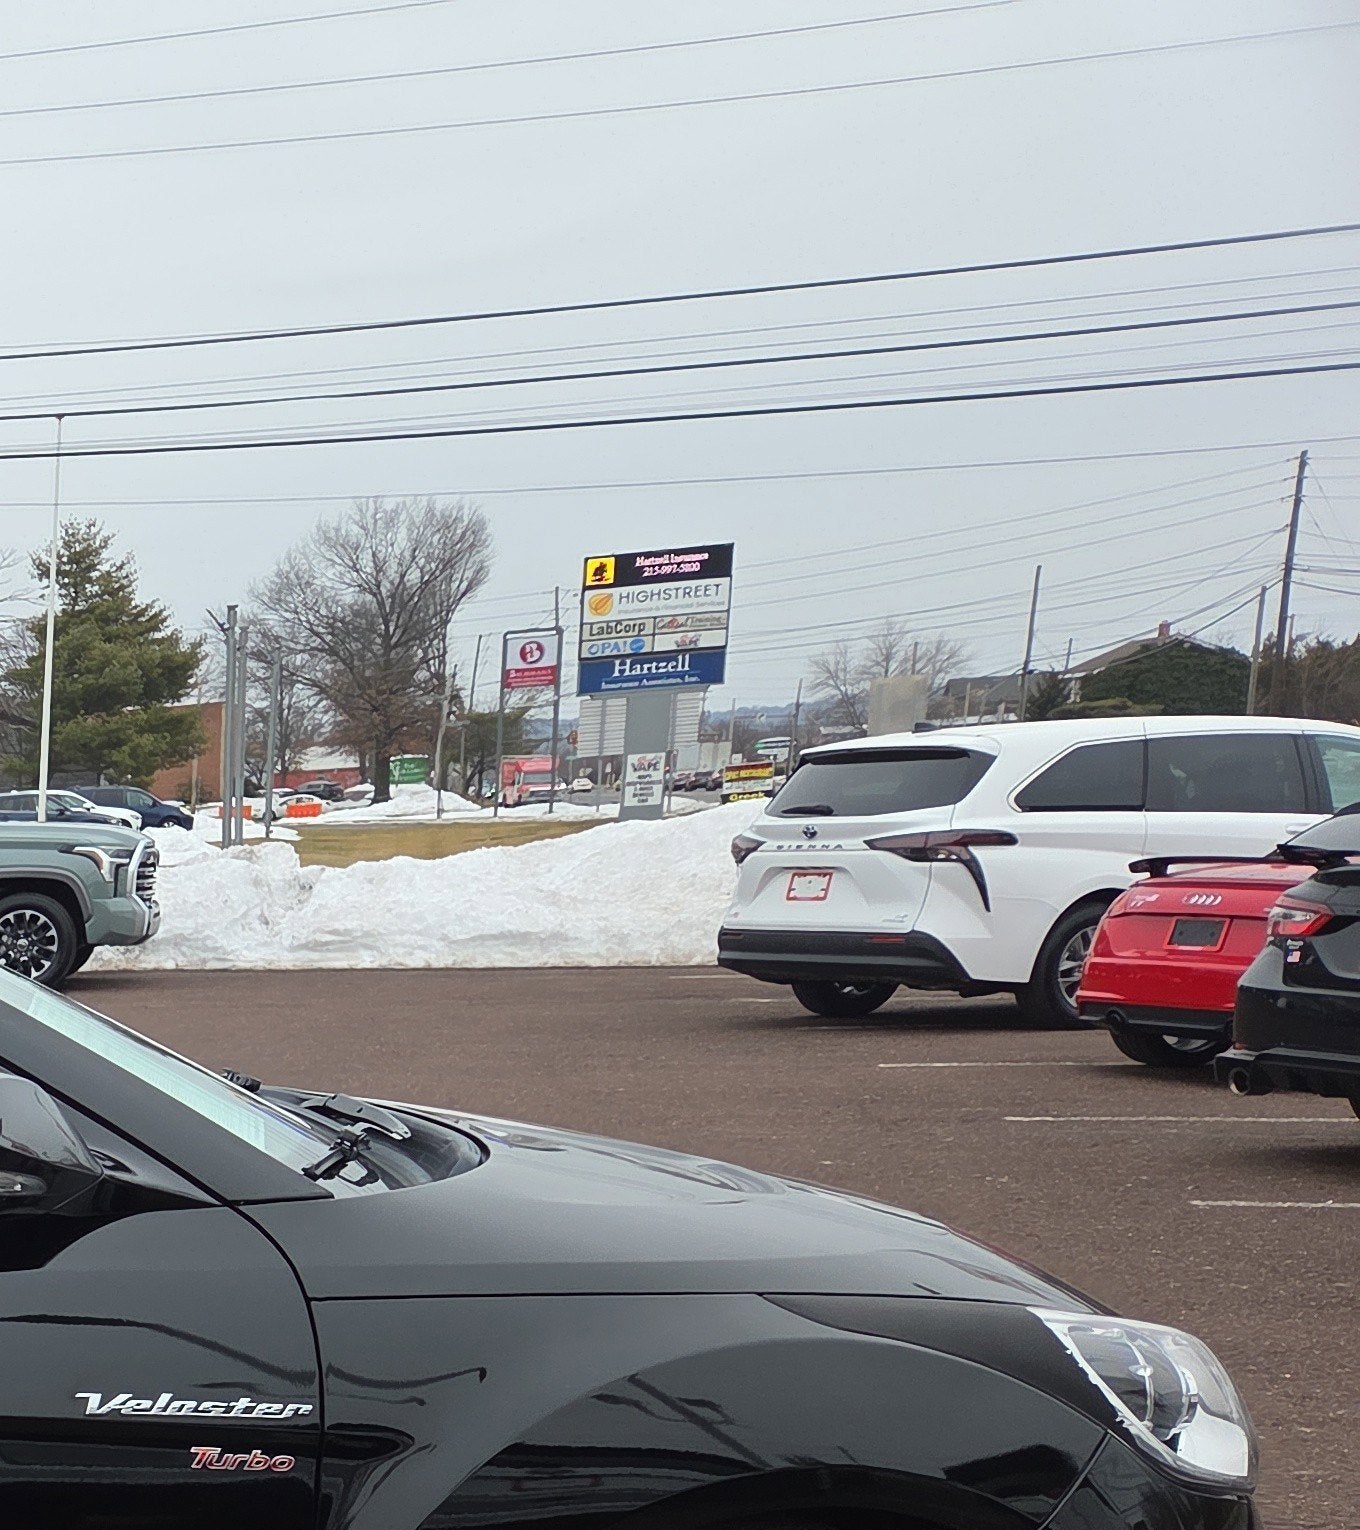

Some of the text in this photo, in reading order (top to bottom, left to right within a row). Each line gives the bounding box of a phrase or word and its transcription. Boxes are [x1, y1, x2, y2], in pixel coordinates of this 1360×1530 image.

[618, 583, 723, 605] HIGHSTREET
[589, 621, 646, 637] LabCorp
[612, 653, 690, 677] Hartzell
[74, 1392, 313, 1419] Veloster
[190, 1446, 295, 1472] Turbo
